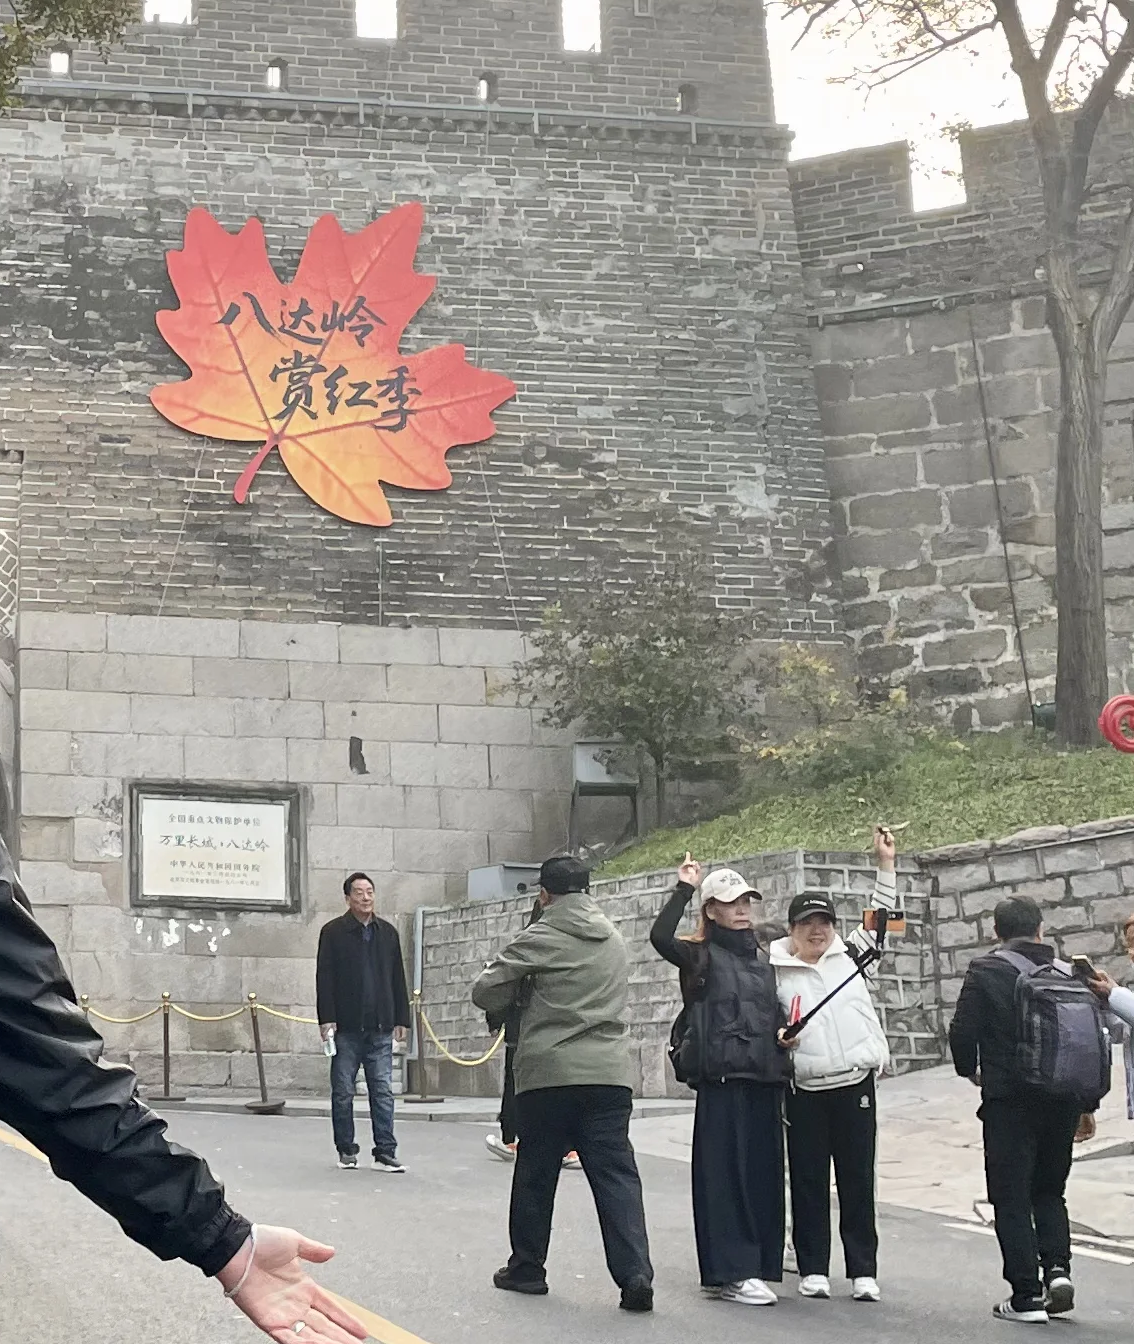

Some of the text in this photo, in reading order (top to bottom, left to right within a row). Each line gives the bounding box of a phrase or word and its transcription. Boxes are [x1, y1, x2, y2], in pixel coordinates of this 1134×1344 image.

[214, 291, 387, 347] 八达岭
[266, 350, 422, 432] 赏红季
